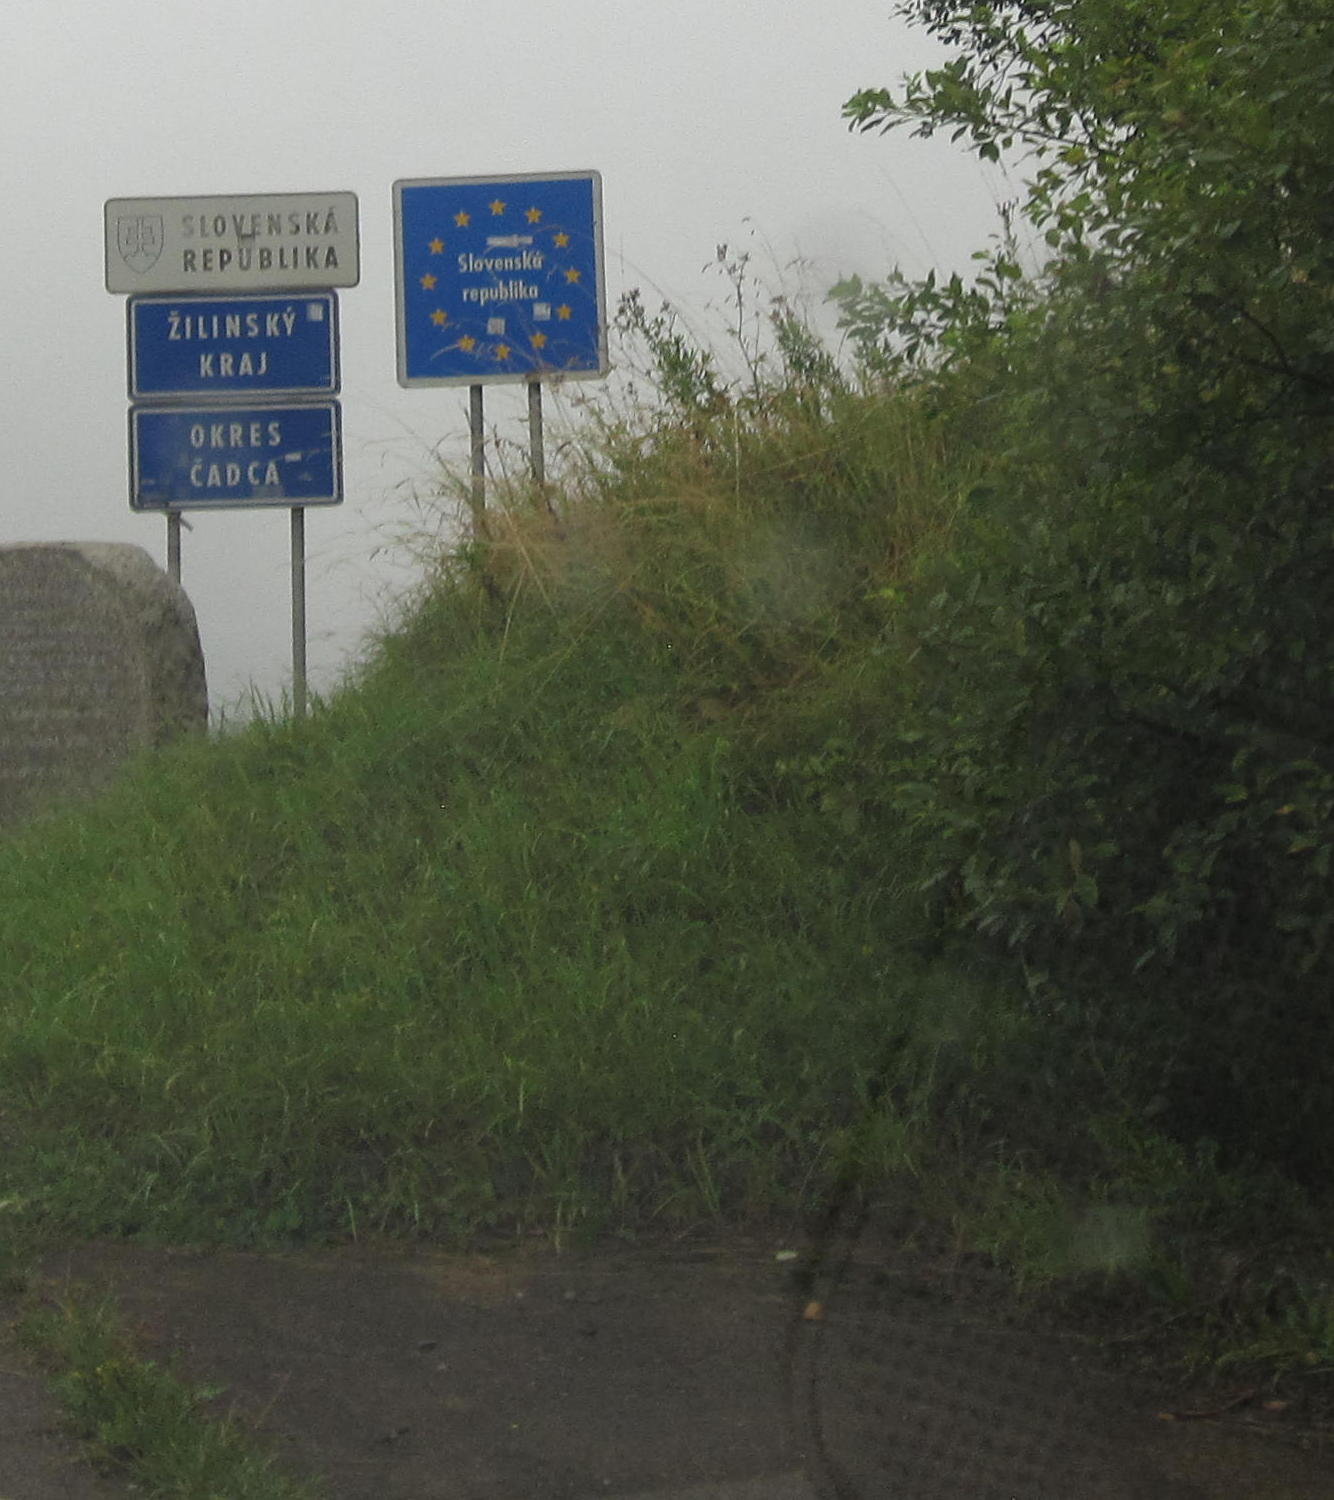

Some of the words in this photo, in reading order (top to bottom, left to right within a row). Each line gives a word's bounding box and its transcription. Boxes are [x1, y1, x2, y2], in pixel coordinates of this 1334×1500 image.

[181, 205, 340, 238] SLOVENSKÁ
[183, 246, 340, 272] REPUBLIKA
[458, 250, 544, 273] Slovenská
[462, 280, 539, 307] republika
[168, 306, 295, 340] ŽILINSKÝ
[199, 352, 267, 377] KRAJ
[190, 422, 281, 449] OKRES
[190, 457, 280, 487] ČADCA
